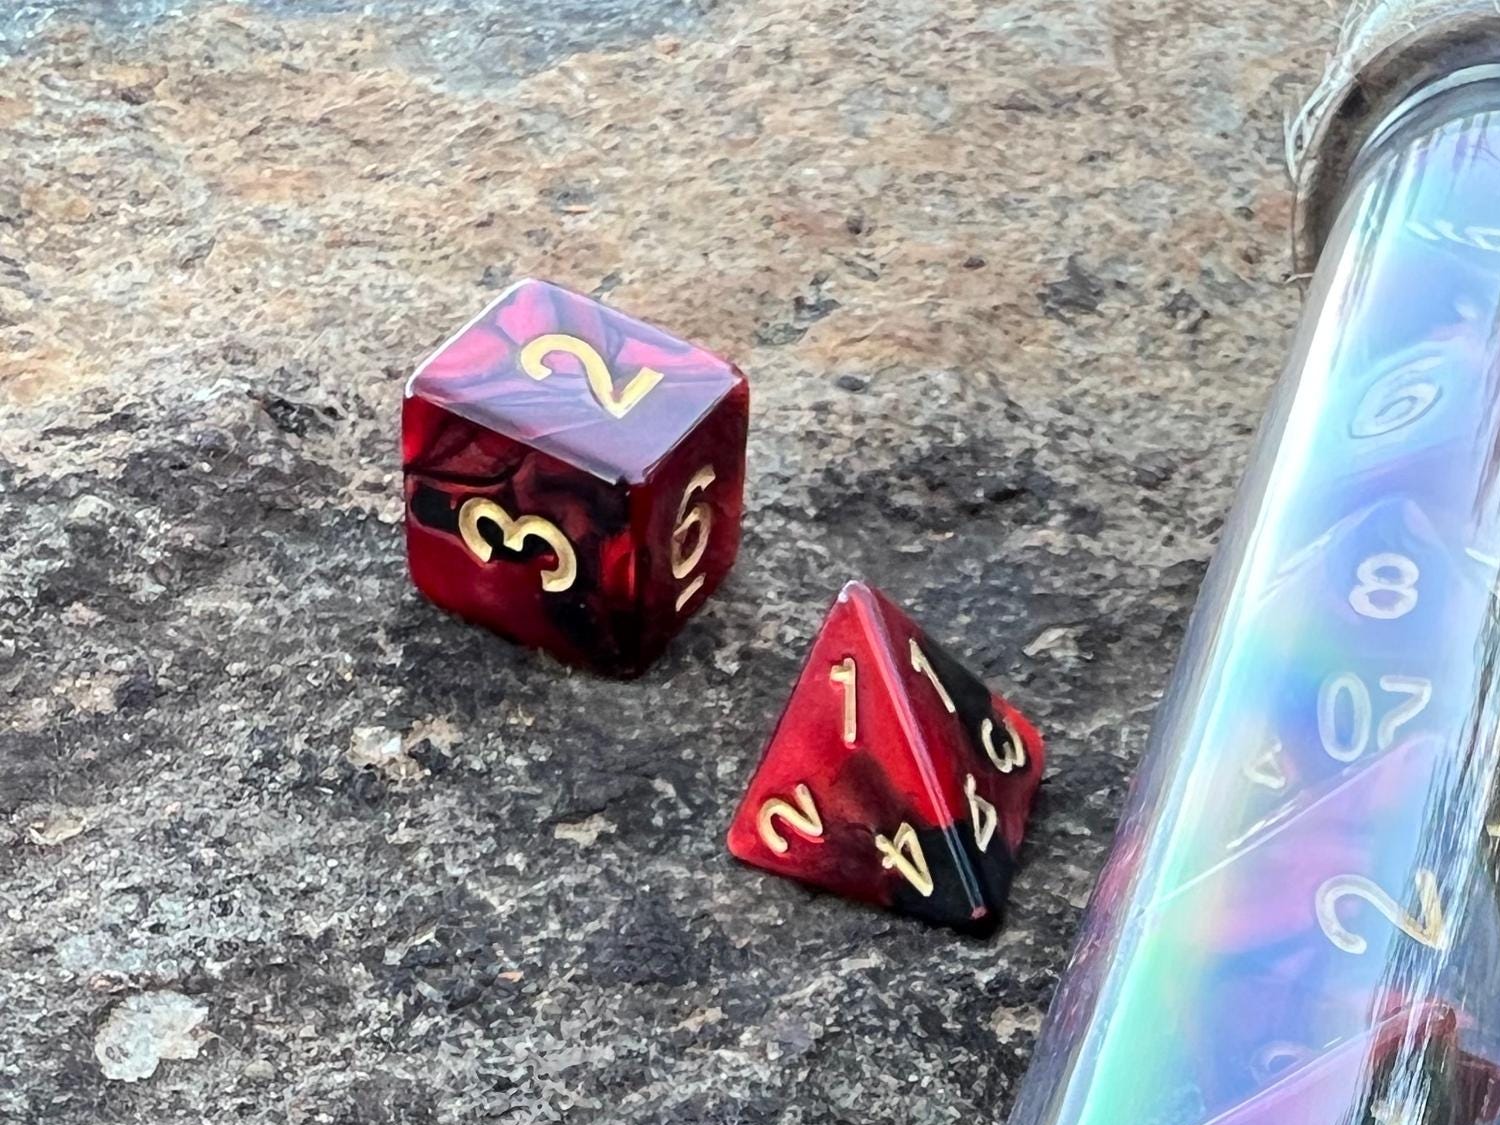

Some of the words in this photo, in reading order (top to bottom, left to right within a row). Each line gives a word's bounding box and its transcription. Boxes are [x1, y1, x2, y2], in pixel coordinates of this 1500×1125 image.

[520, 333, 664, 420] 2
[458, 497, 578, 593] 3
[1348, 551, 1420, 620] 8
[829, 656, 857, 744] 1
[908, 637, 957, 714] 1
[980, 717, 1027, 774] 3
[757, 783, 824, 854] 2
[963, 772, 998, 854] 4
[874, 821, 935, 898] 4
[1314, 873, 1446, 955] 2
